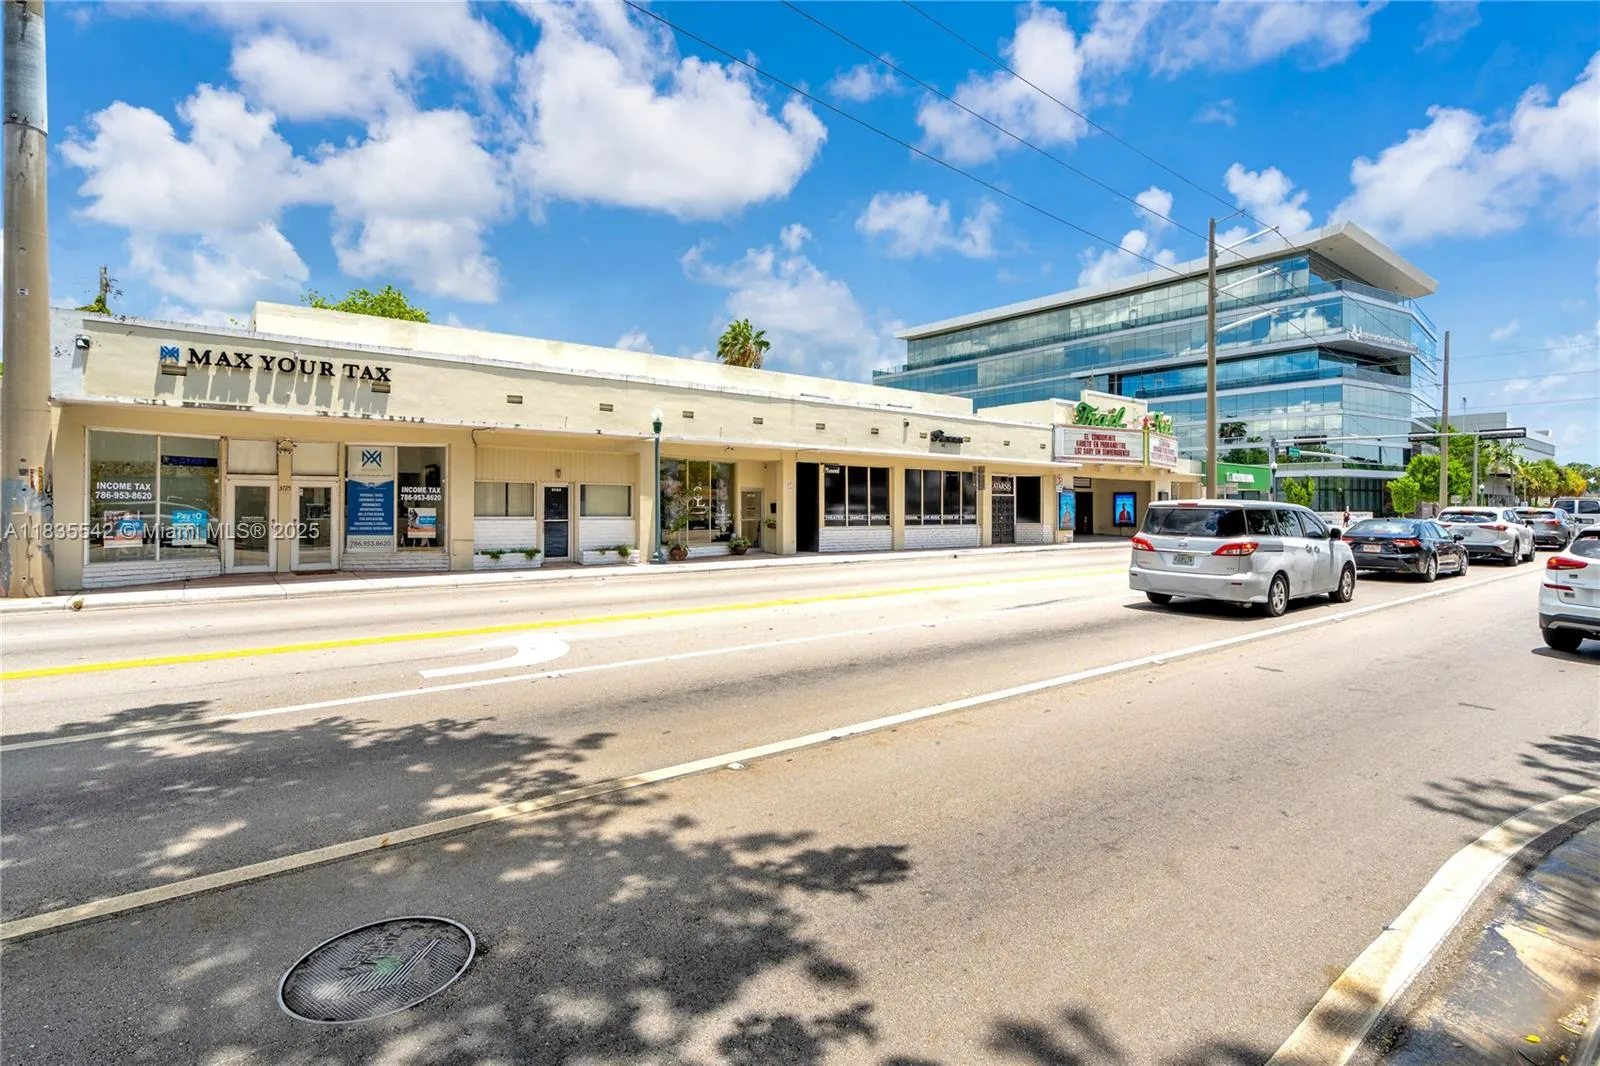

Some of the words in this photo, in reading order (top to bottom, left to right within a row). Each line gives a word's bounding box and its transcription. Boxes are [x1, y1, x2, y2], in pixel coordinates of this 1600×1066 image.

[187, 348, 253, 369] MAX
[260, 355, 336, 377] YOUR
[342, 363, 392, 382] TAX
[96, 481, 133, 490] INCOME
[134, 483, 151, 491] TAX
[95, 491, 152, 500] 786-953-8620
[400, 493, 442, 501] 786-953-8620
